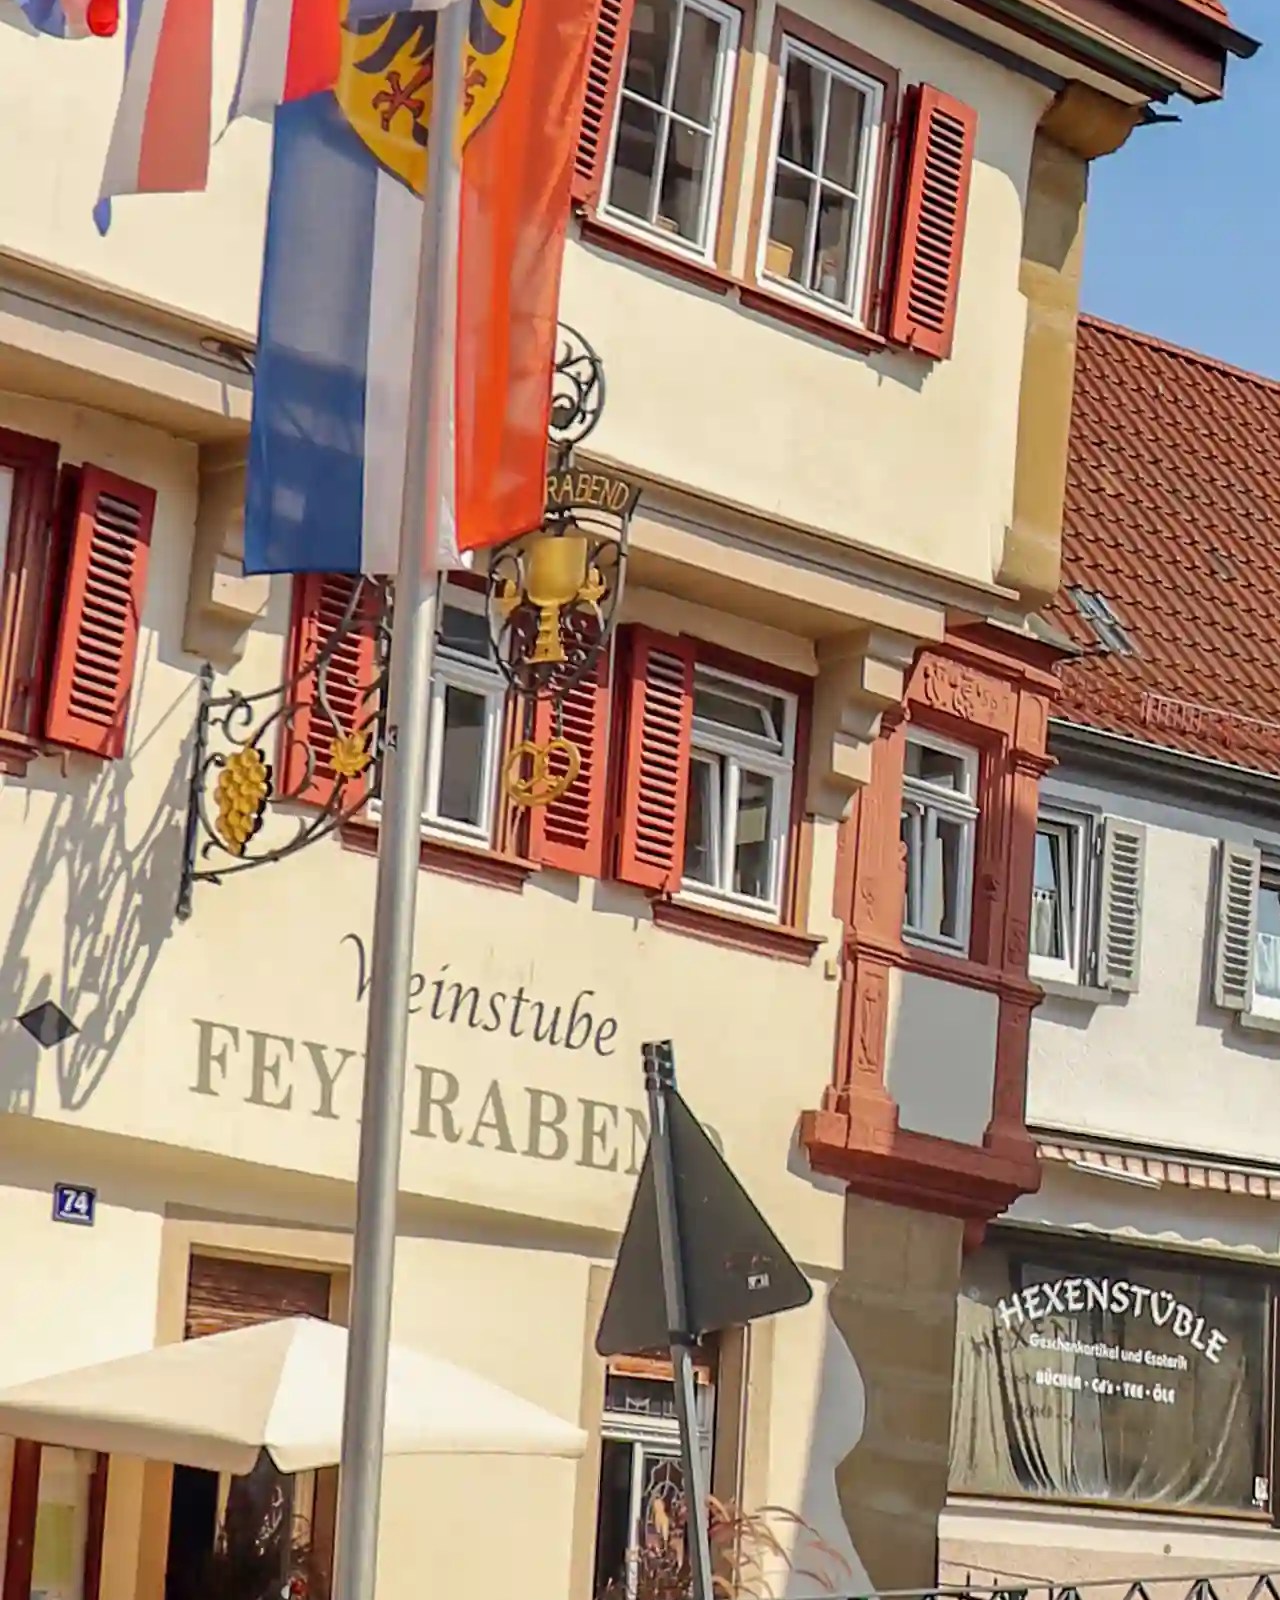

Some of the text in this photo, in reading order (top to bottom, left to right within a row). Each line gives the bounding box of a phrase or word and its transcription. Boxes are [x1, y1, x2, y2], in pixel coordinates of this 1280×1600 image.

[189, 1018, 724, 1176] FEYRABEN
[63, 1189, 89, 1214] 74
[997, 1277, 1229, 1364] HEXENSTÜBLE
[1029, 1333, 1119, 1361] Geschenkartikel
[1121, 1349, 1142, 1364] und
[1144, 1350, 1188, 1371] Esoterik
